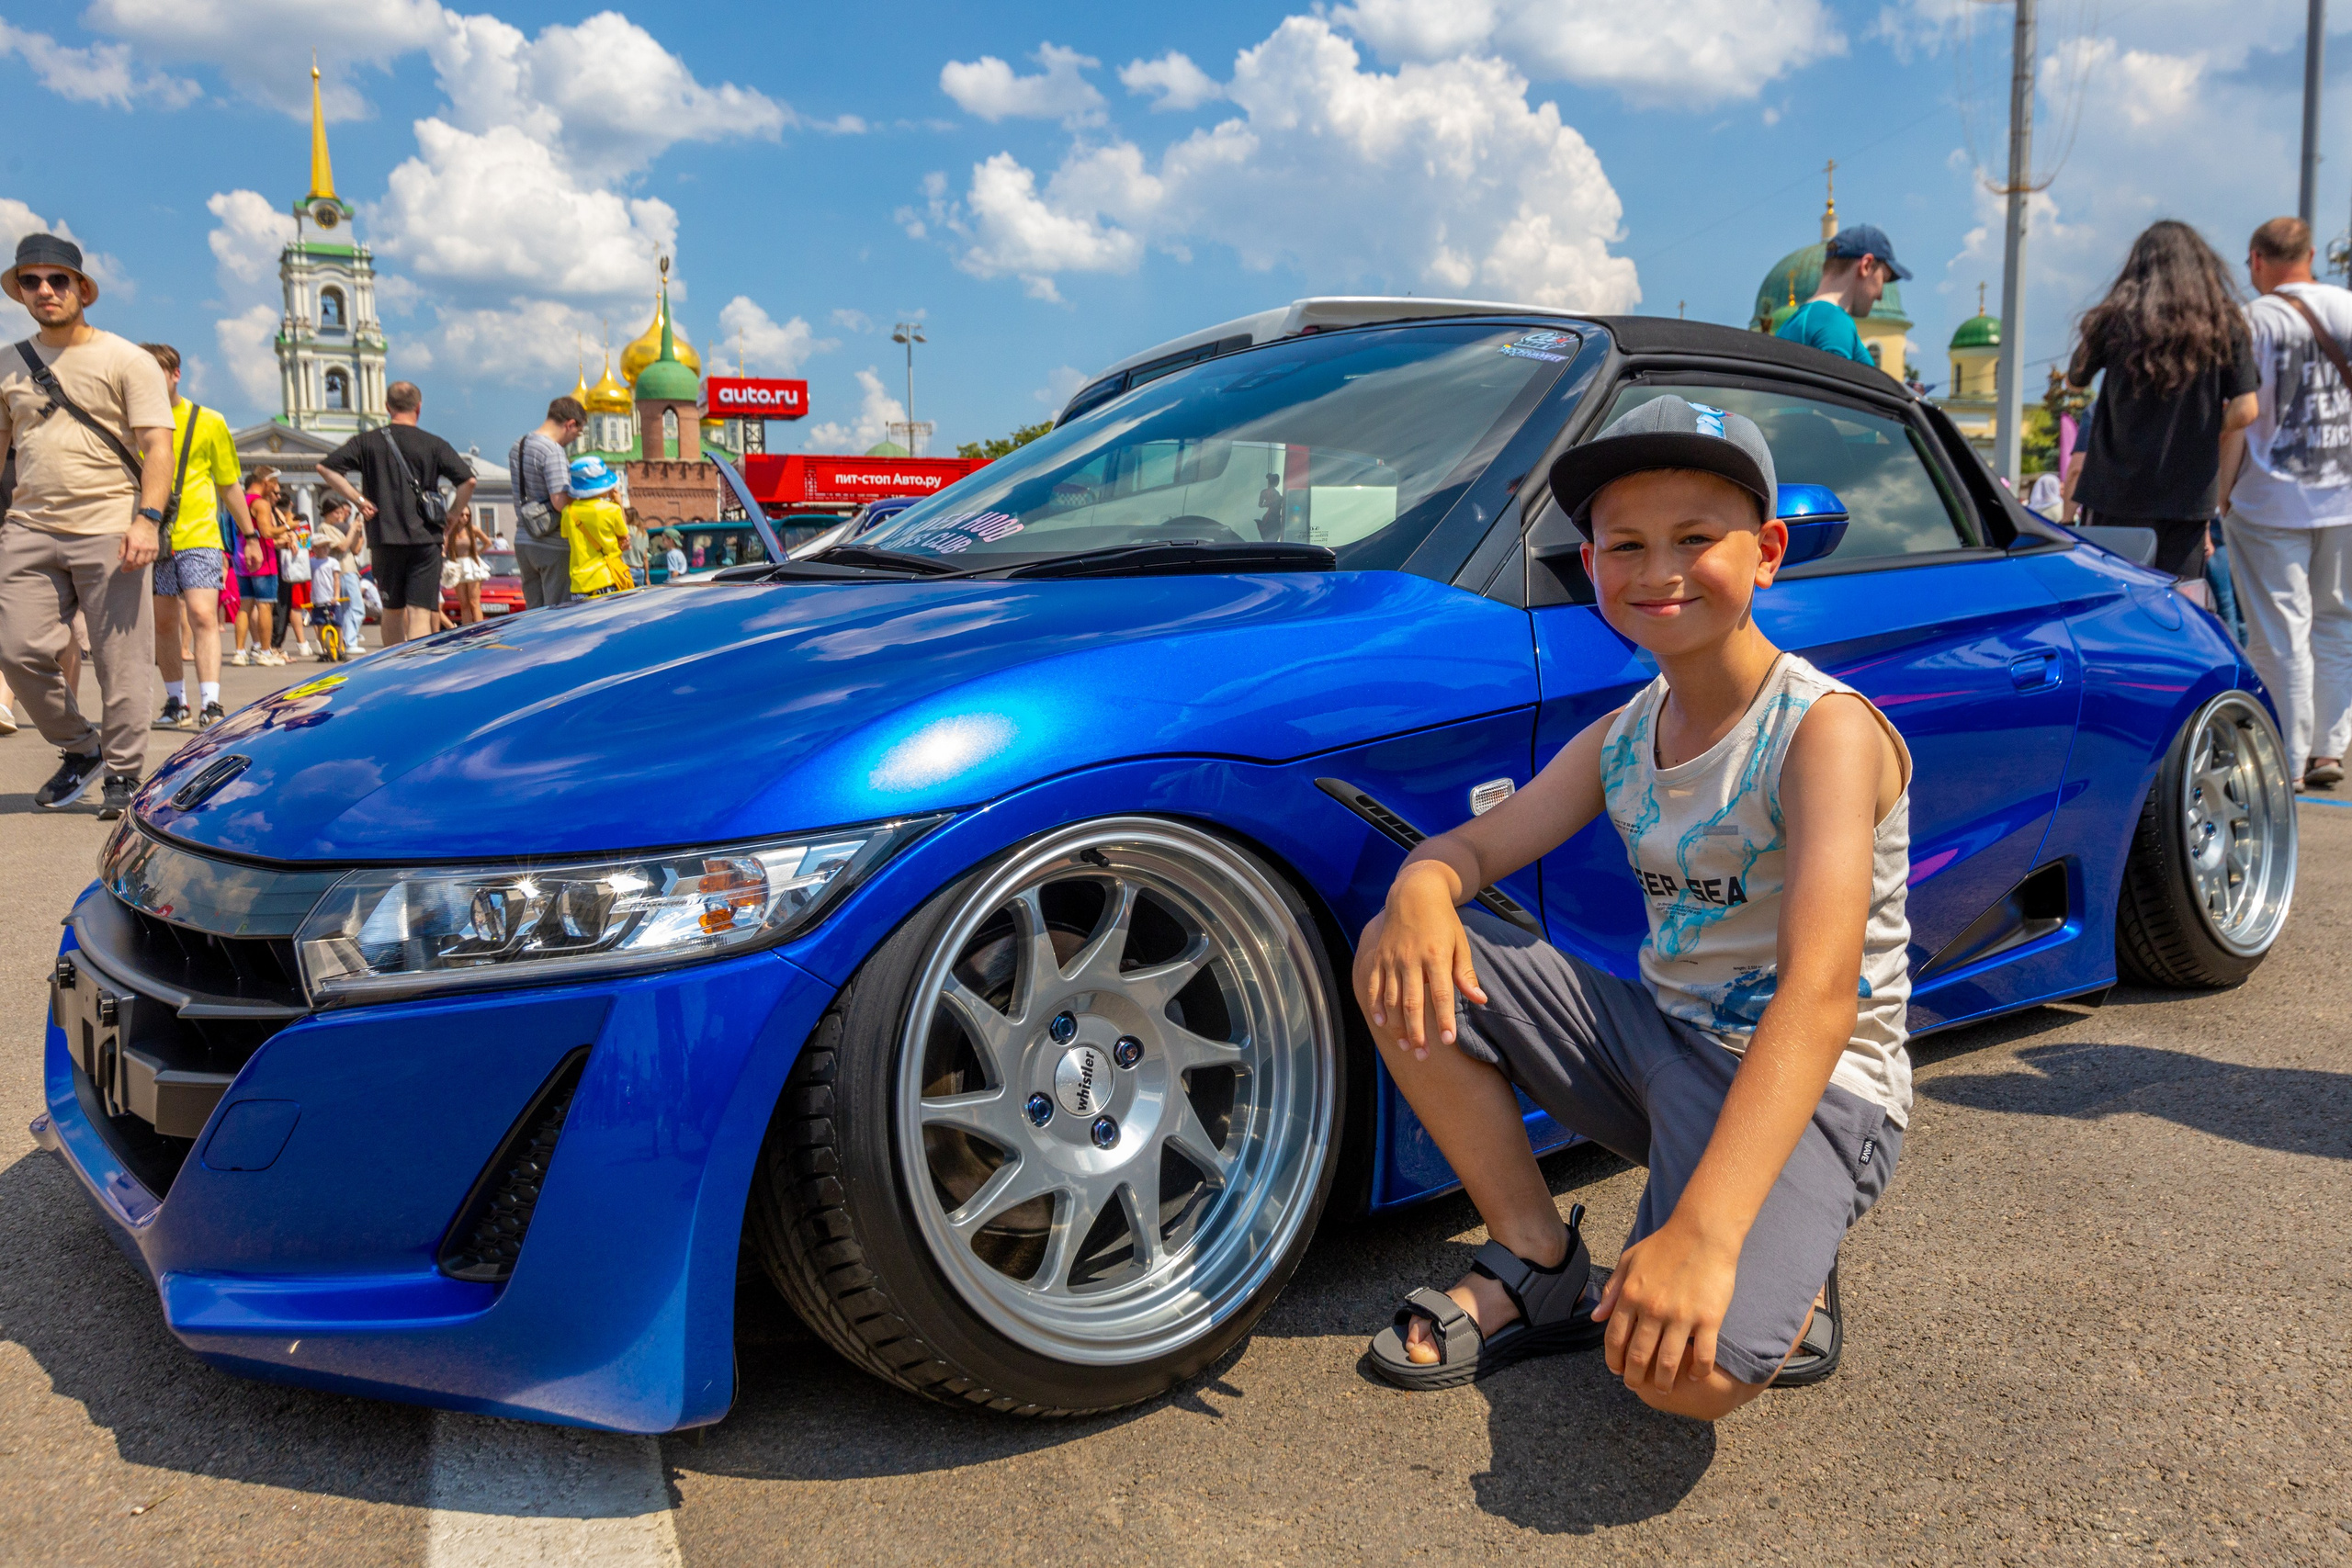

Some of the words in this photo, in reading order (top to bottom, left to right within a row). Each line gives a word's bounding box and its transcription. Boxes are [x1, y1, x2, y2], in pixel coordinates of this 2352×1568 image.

[718, 386, 798, 405] auto.ru
[835, 473, 891, 485] пит-стоп
[892, 472, 942, 489] Авто.ру
[880, 511, 978, 545] UNDER
[959, 511, 1025, 543] HOOD
[1630, 864, 1679, 897] EEP
[1685, 876, 1748, 907] SEA
[1077, 1050, 1095, 1111] whistler
[1860, 1140, 1872, 1163] WAVE
